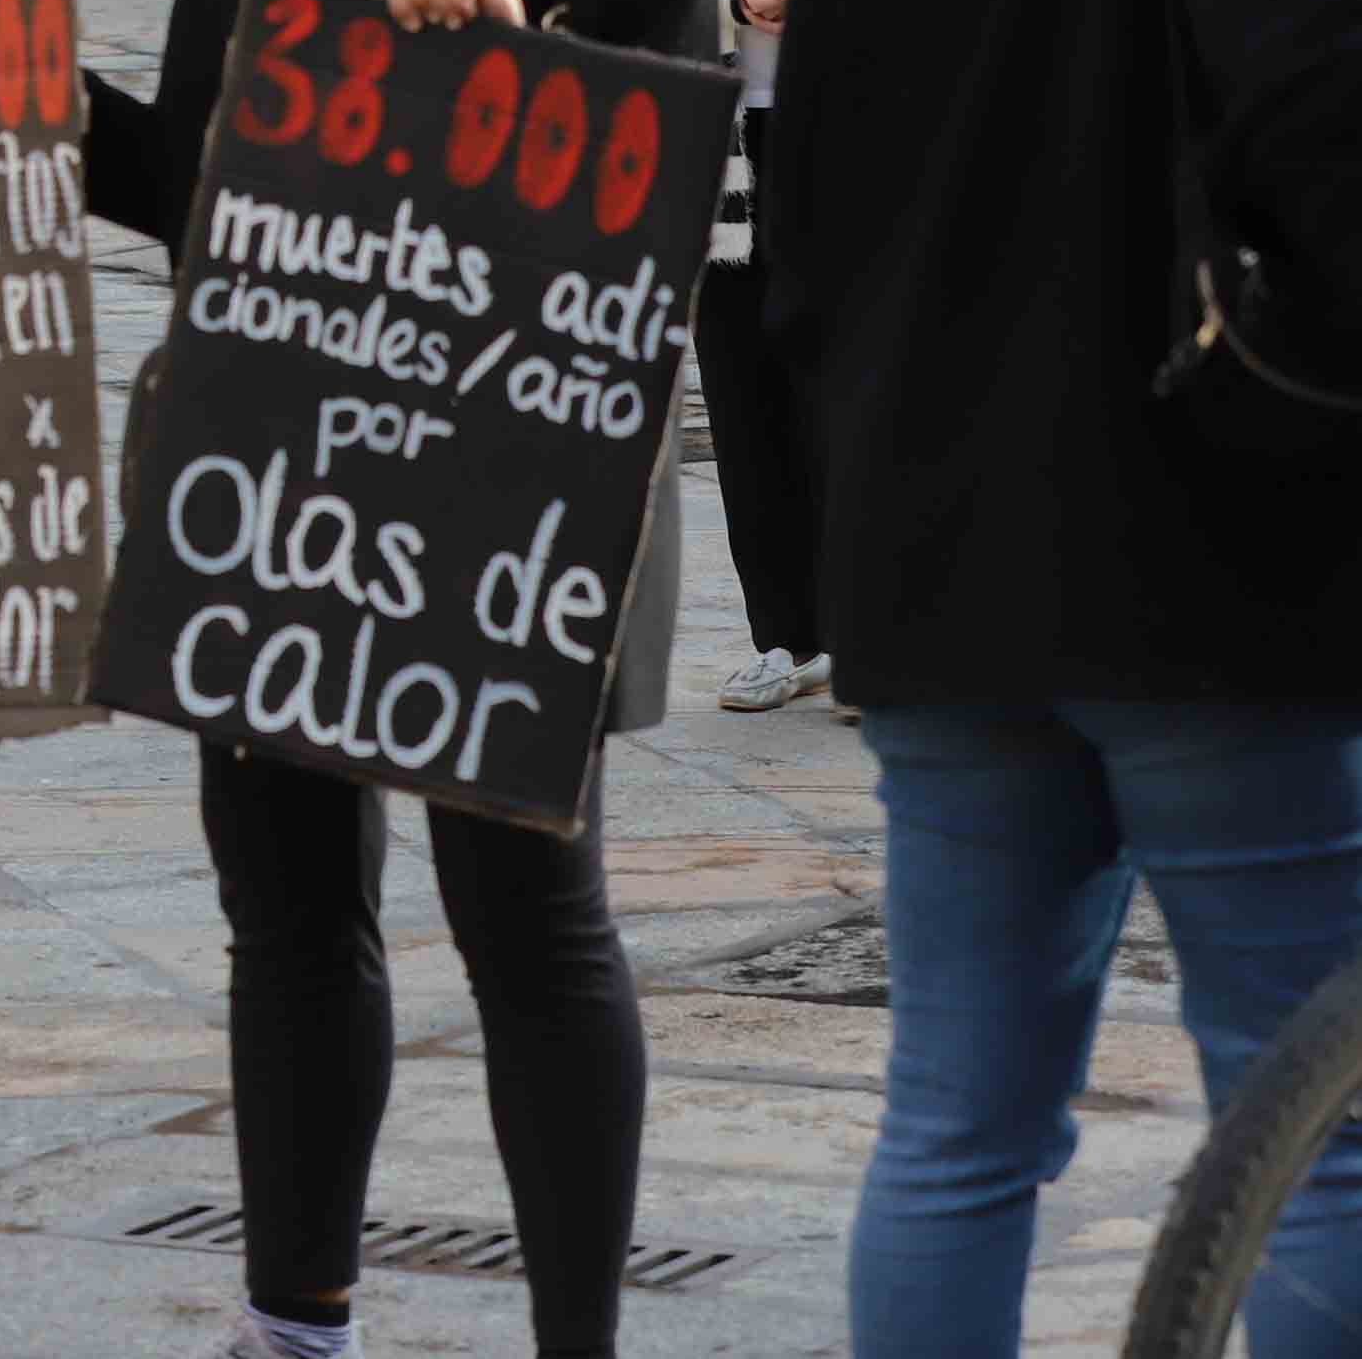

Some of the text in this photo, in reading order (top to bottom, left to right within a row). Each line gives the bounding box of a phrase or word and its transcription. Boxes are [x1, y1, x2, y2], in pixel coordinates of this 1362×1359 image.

[209, 188, 693, 361] muertes adi-
[30, 464, 89, 561] de
[314, 397, 455, 477] por
[475, 498, 607, 664] de
[172, 613, 541, 781] calor
